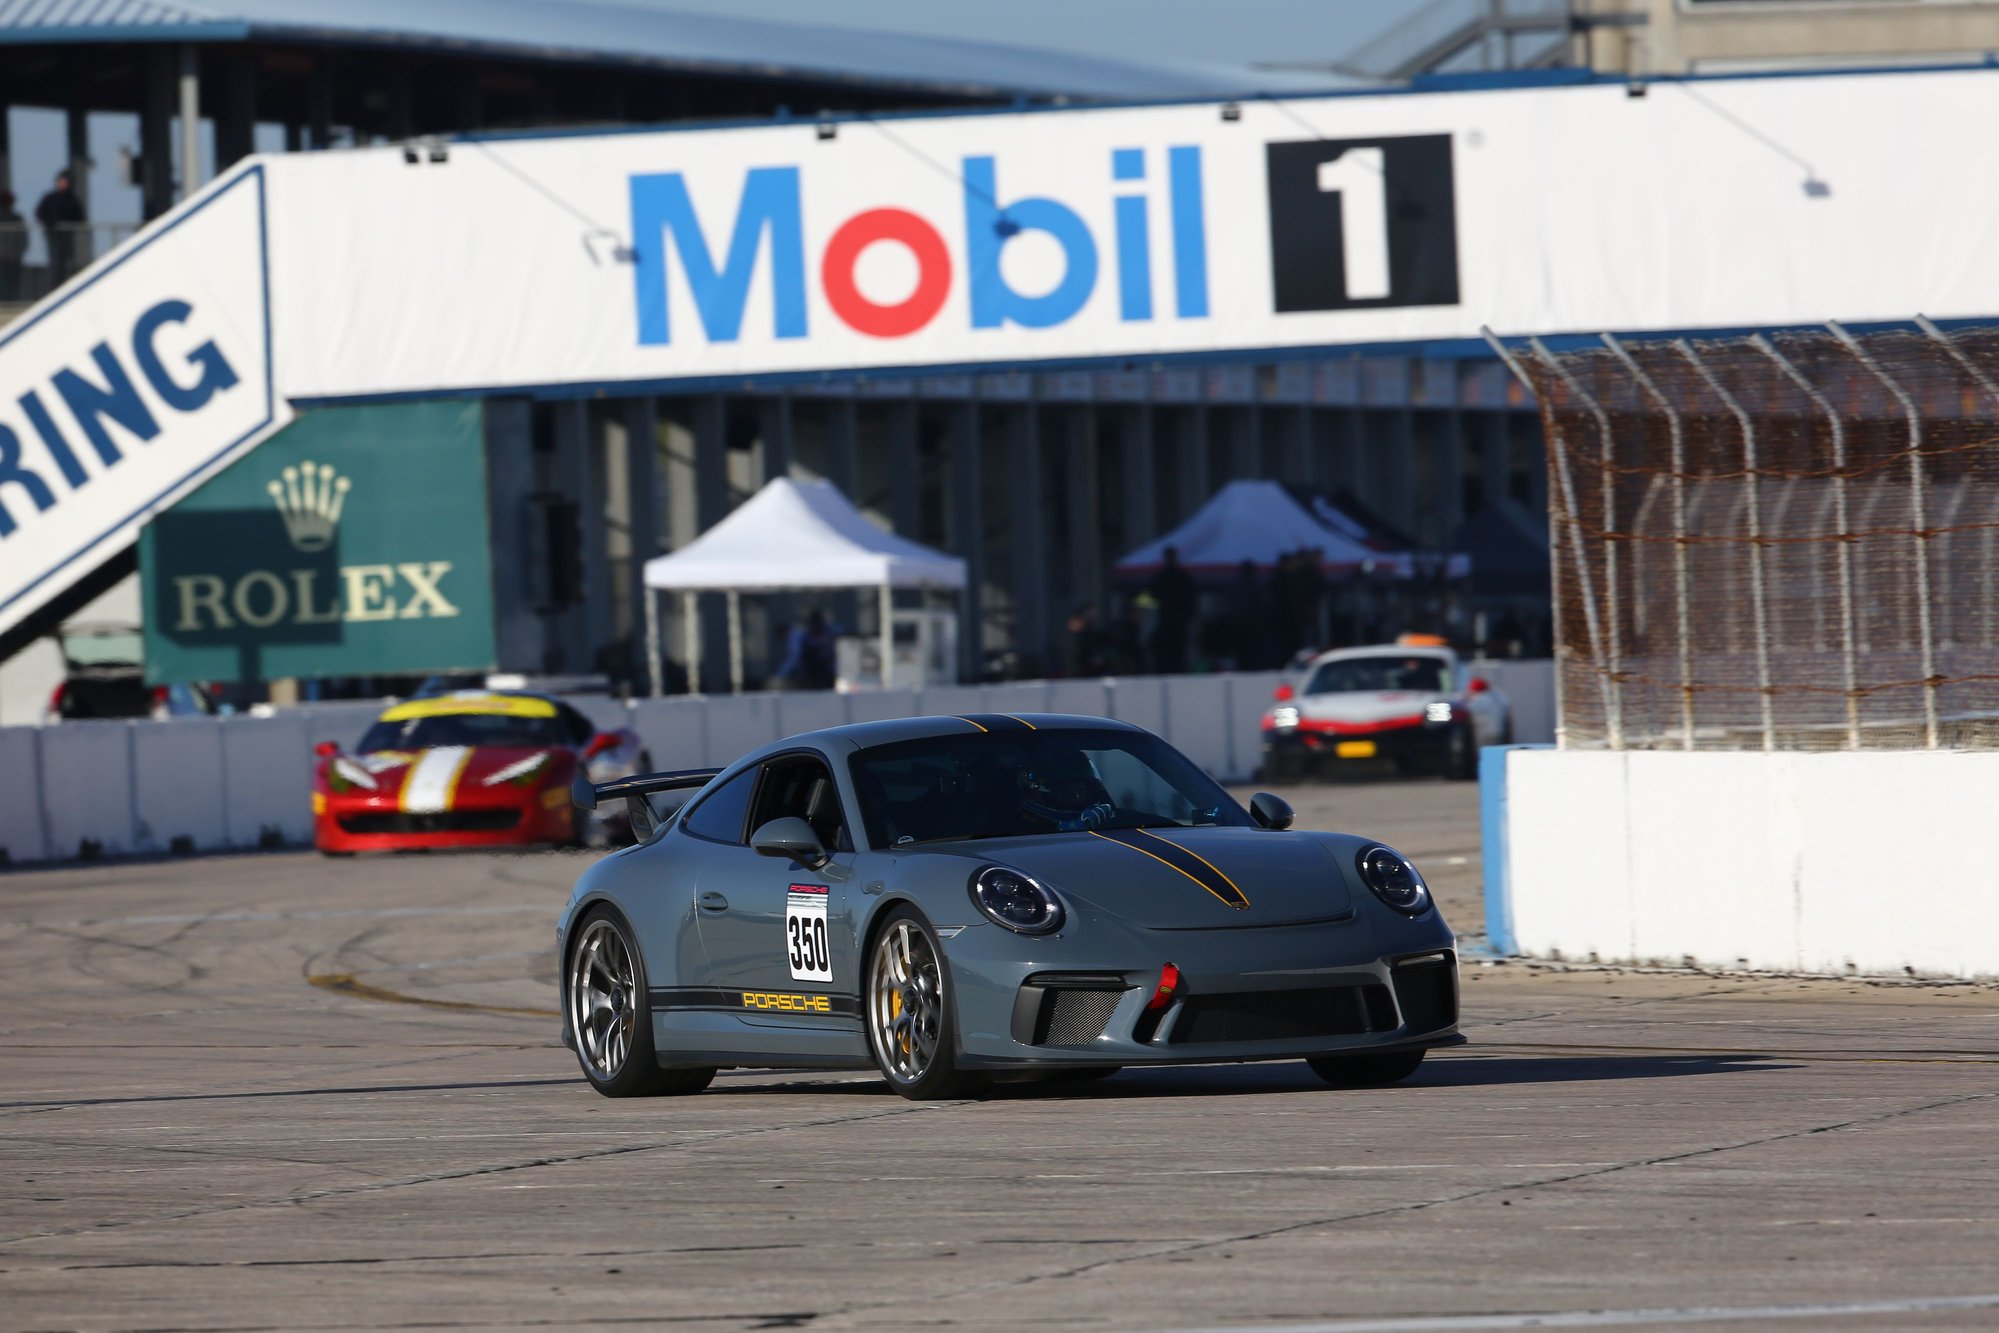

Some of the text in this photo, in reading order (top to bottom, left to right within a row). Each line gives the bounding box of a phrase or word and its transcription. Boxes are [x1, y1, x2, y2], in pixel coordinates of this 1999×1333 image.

[628, 145, 1390, 346] Mobil 1
[174, 561, 459, 630] ROLEX
[789, 916, 828, 971] 350
[743, 993, 831, 1011] PORSCHE
